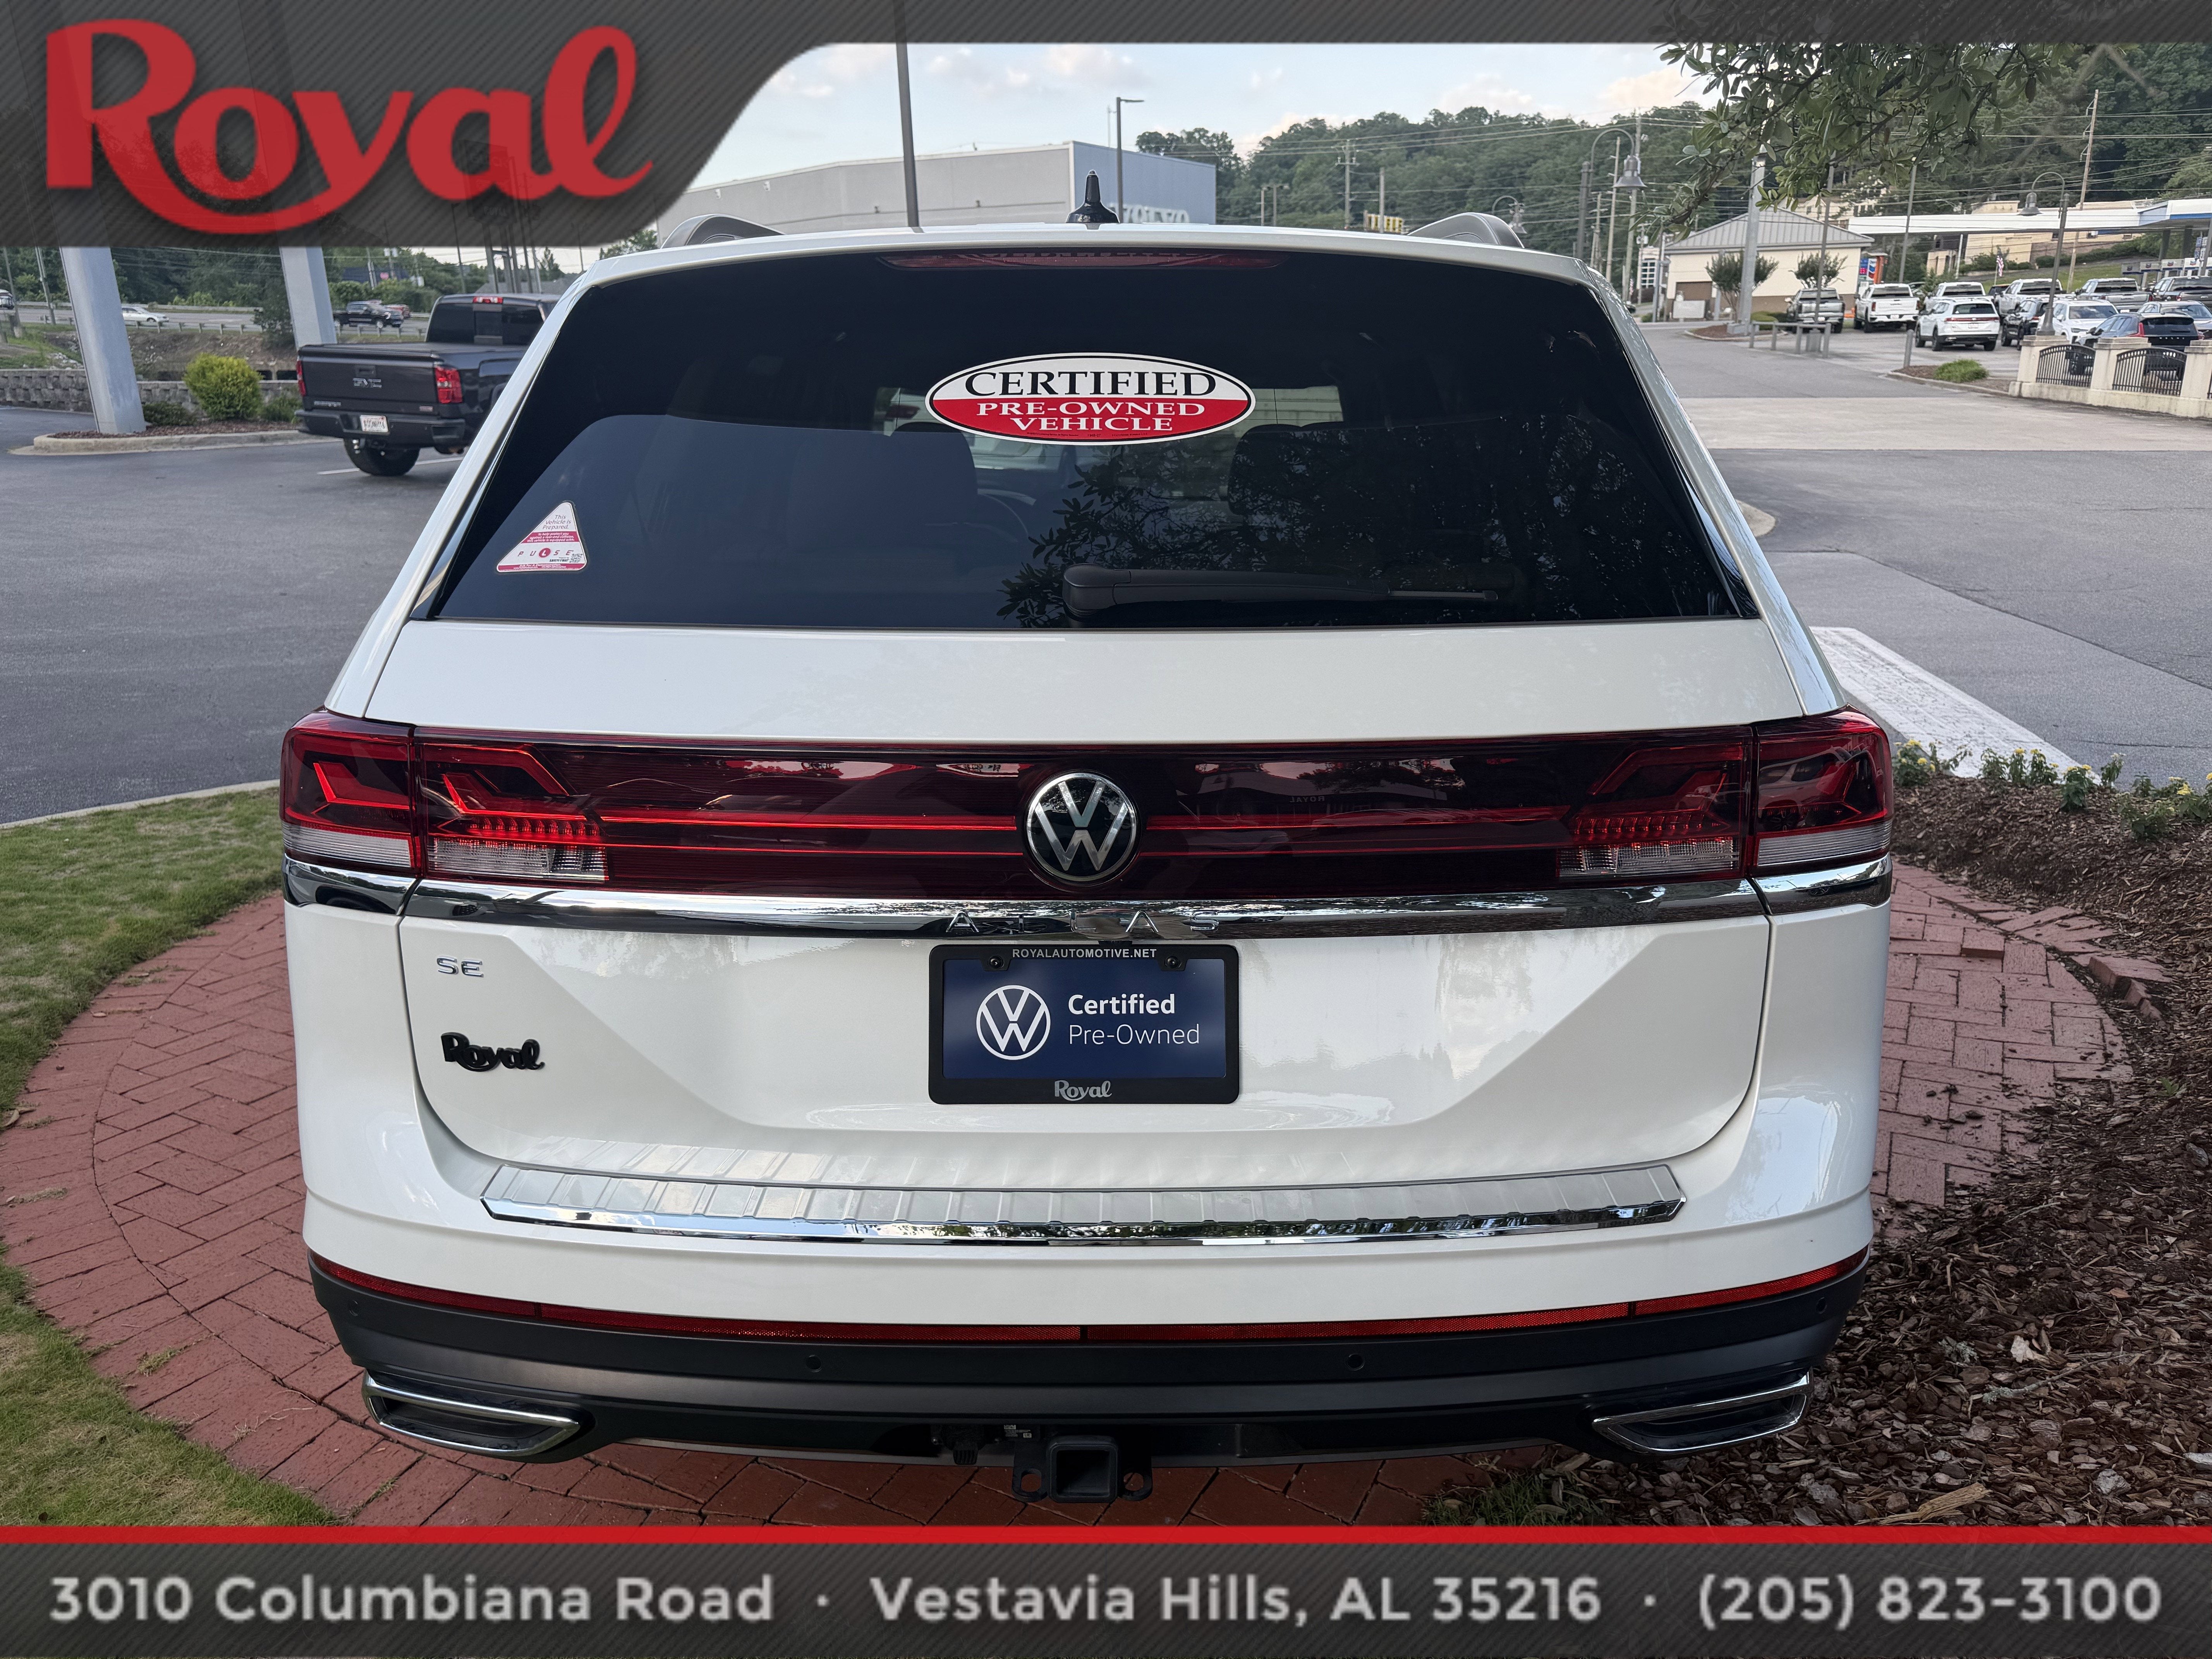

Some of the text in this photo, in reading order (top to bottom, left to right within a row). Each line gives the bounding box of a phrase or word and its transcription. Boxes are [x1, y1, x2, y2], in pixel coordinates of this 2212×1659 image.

[965, 371, 1216, 397] CERTIFIED
[976, 402, 1205, 417] PRE-OWNED
[1010, 417, 1173, 431] VEHICLE
[946, 911, 1219, 933] ATLAS
[1012, 949, 1157, 958] ROYALAUTOMOTIVE.NET
[436, 955, 484, 977] SE
[1068, 994, 1175, 1015] Certified
[1070, 1024, 1200, 1045] Pre-Owned
[441, 1032, 545, 1072] Royal
[1054, 1080, 1112, 1101] Royal
